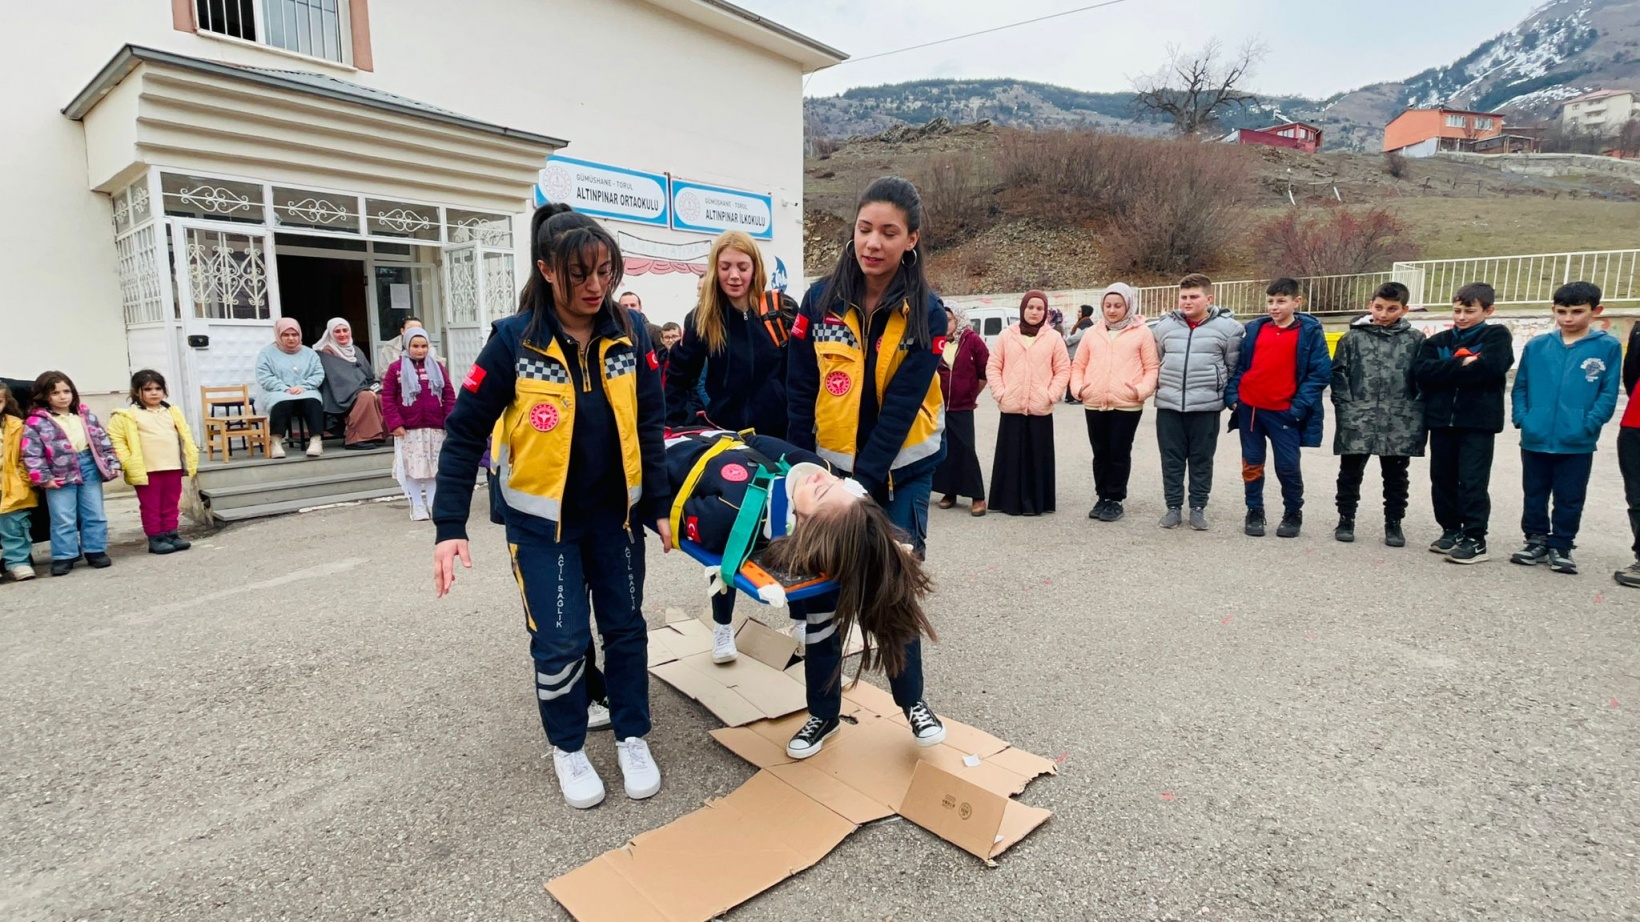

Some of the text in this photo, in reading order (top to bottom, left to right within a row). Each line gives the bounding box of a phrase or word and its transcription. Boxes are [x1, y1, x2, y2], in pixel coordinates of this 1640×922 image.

[616, 180, 633, 190] TORUL
[576, 186, 659, 211] ALTINPINAR ORTAOKULU
[705, 208, 738, 223] ALTINPINAR
